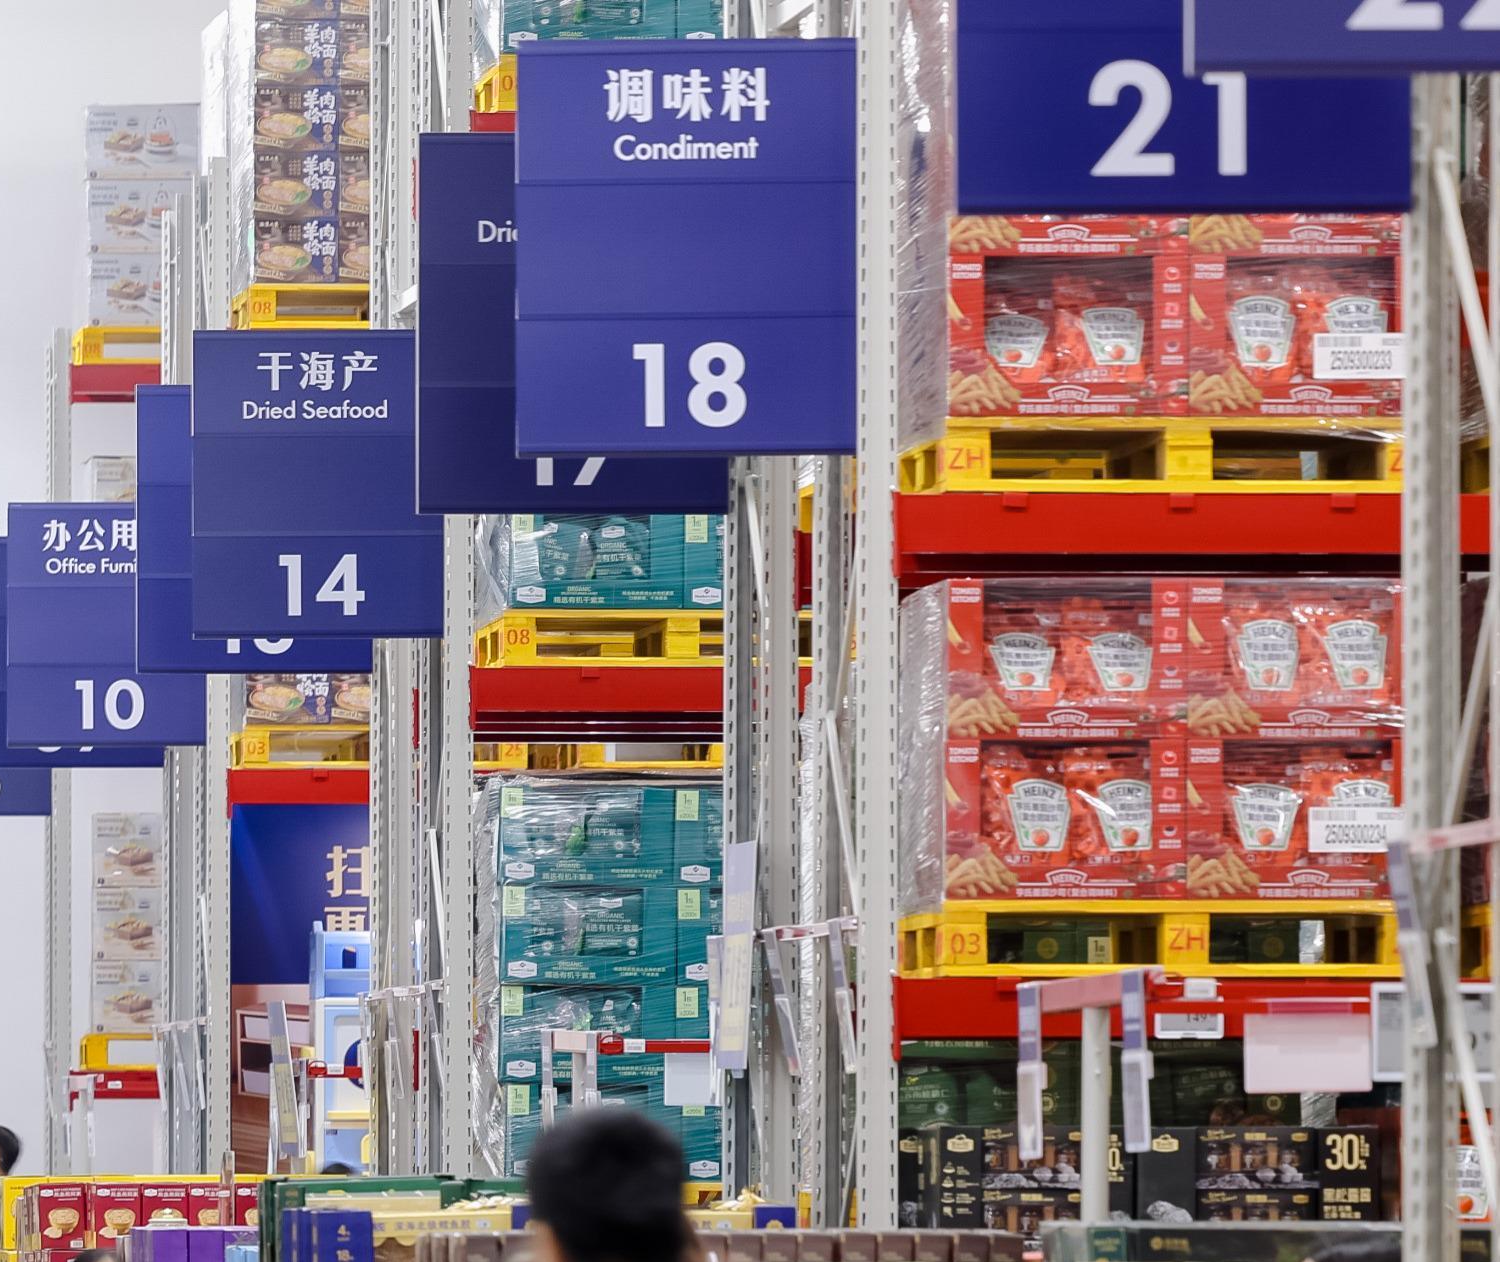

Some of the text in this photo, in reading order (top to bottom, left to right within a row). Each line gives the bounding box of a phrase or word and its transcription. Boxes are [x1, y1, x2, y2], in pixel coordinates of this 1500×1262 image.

[604, 68, 770, 122] 调味料
[1088, 59, 1247, 176] 21
[614, 134, 758, 161] Condiment
[252, 301, 272, 315] 08
[256, 351, 378, 391] 干海产
[632, 342, 747, 427] 18
[242, 400, 388, 420] Dried Seafood
[947, 446, 985, 470] ZH
[41, 519, 136, 552] 办公用
[45, 558, 96, 575] Office
[279, 554, 365, 616] 14
[506, 629, 530, 645] 08
[75, 679, 145, 730] 10
[247, 741, 266, 755] 03
[505, 744, 523, 758] 25
[1023, 786, 1057, 798] HEINZ
[1109, 787, 1142, 798] HEINZ
[951, 934, 981, 955] 03
[1169, 928, 1204, 951] ZH
